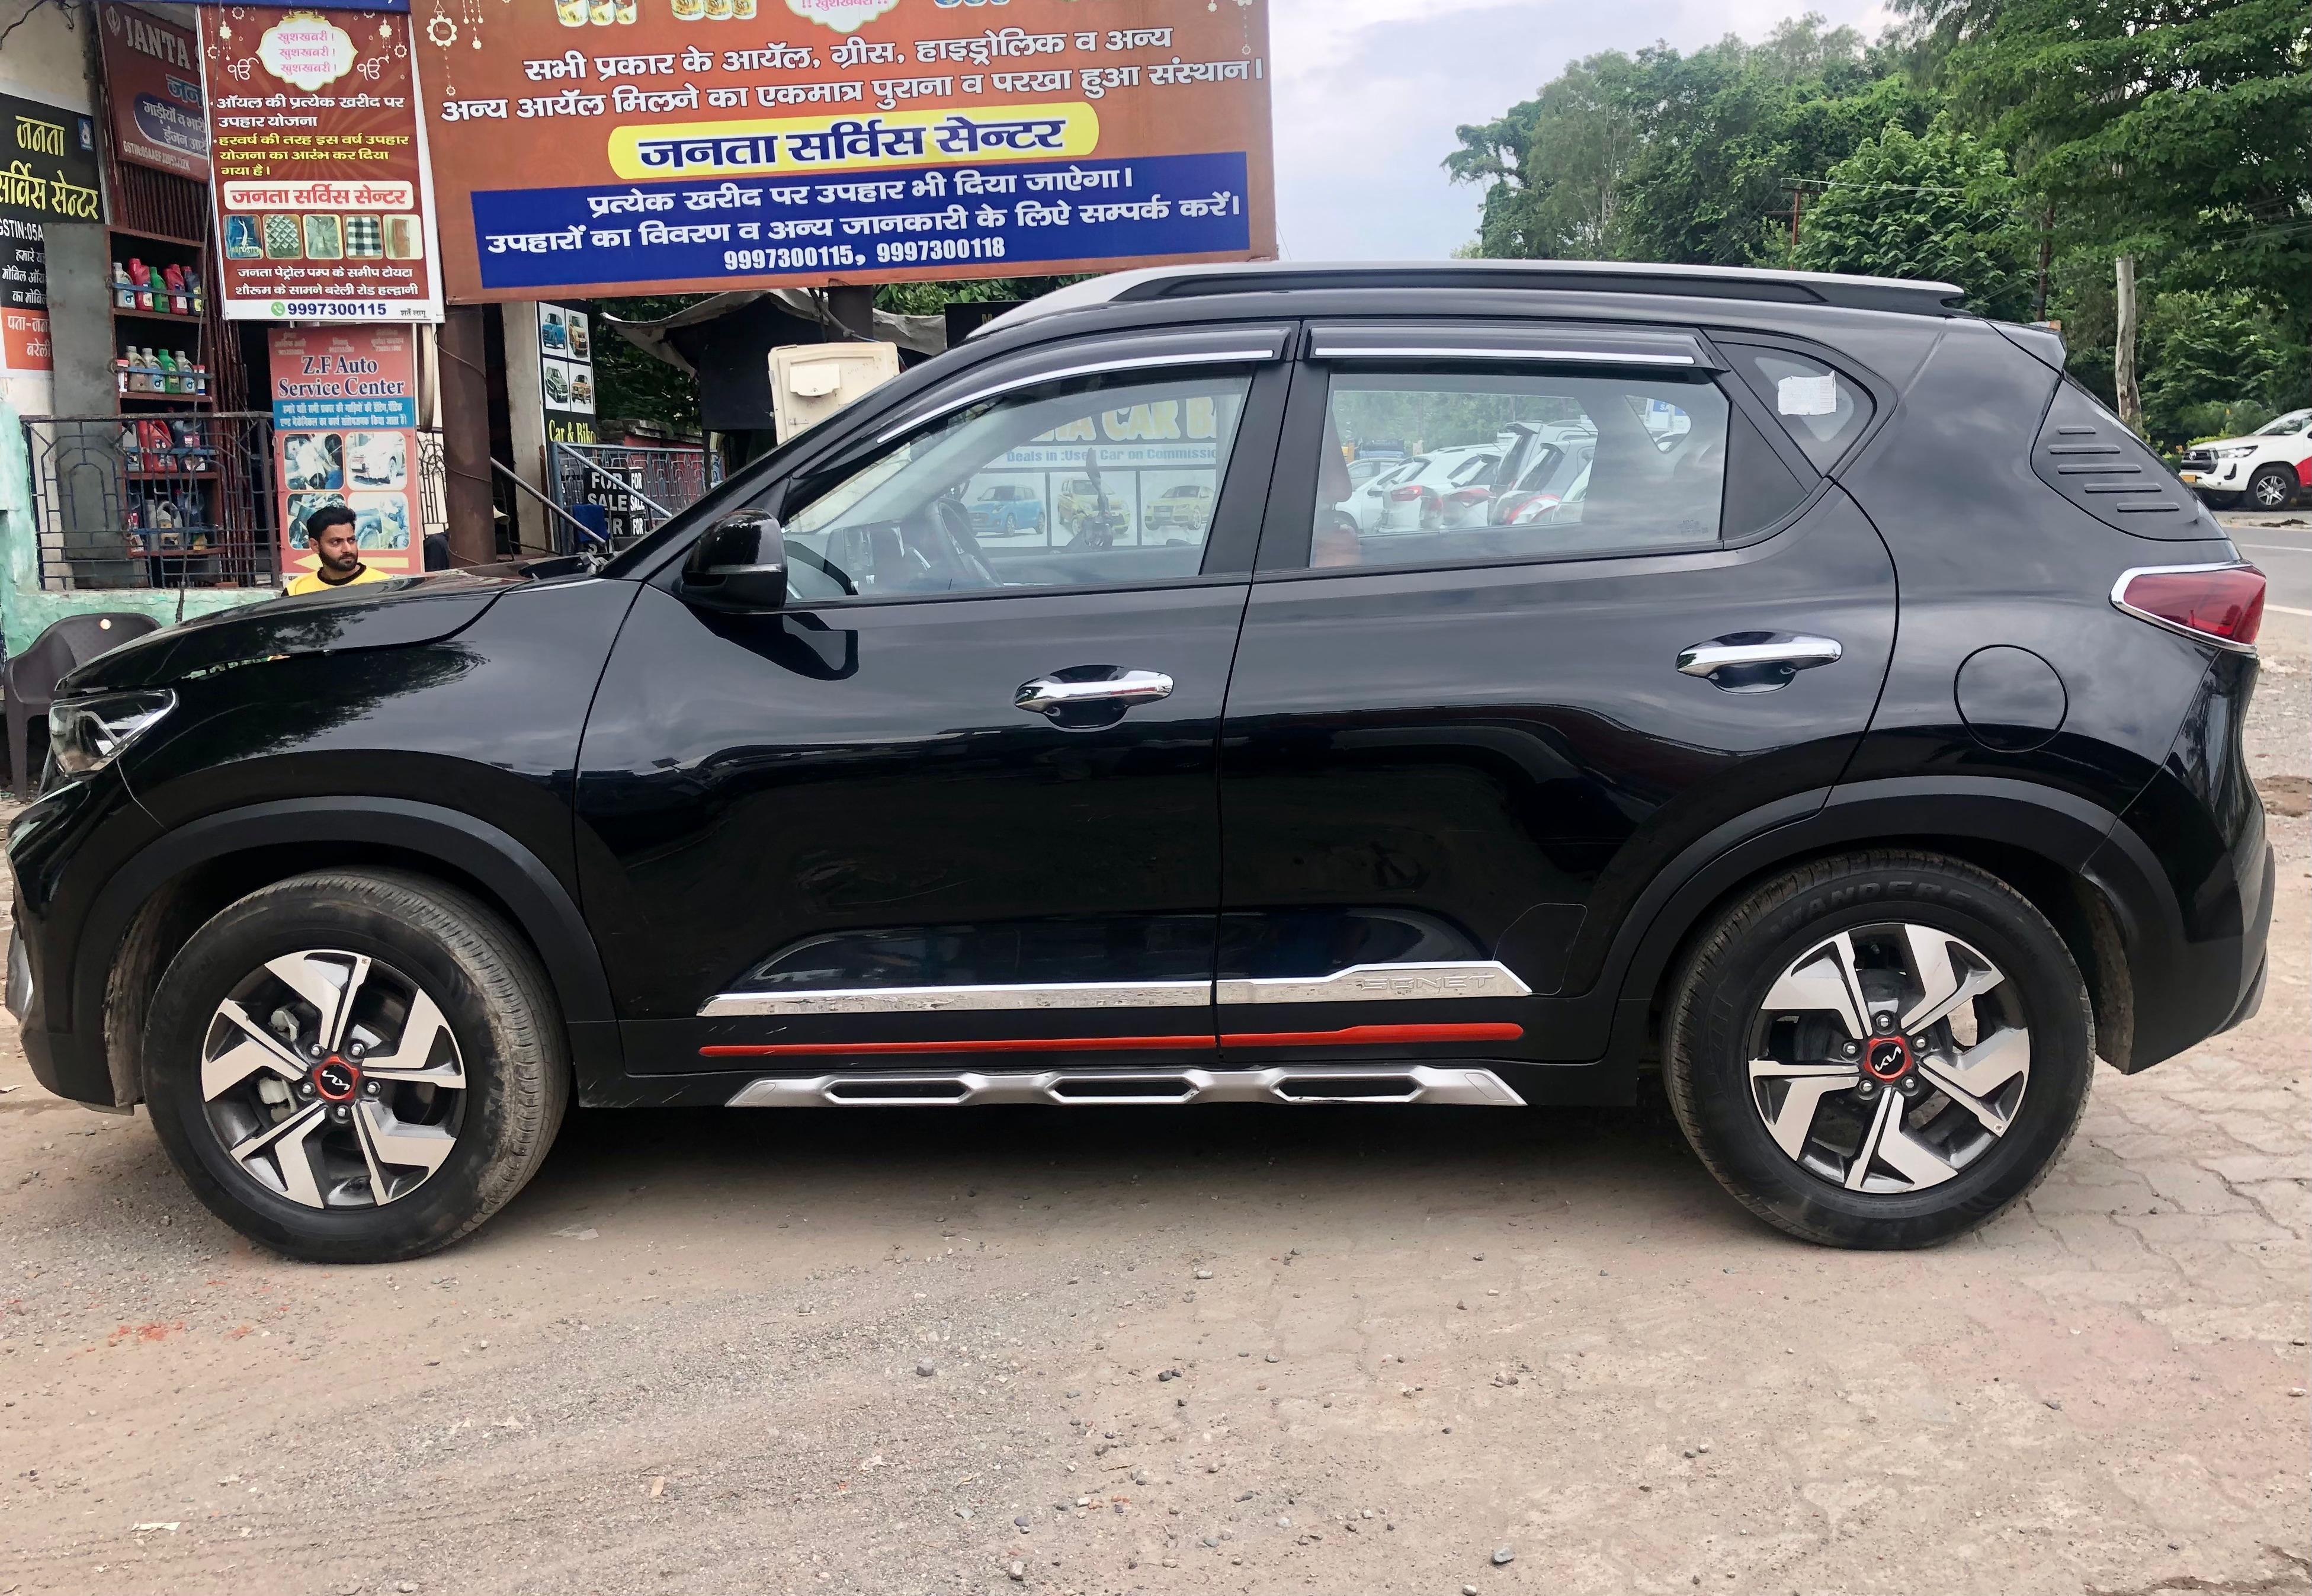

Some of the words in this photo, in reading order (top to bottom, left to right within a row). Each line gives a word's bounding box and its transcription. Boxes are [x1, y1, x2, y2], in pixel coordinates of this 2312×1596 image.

[124, 15, 191, 70] JANTA
[524, 50, 587, 82] सभी
[594, 54, 675, 82] प्रकार
[681, 45, 713, 72] के
[829, 36, 905, 69] ग्रीस,
[916, 28, 1067, 66] हाइड्रोलिक
[1075, 31, 1097, 52] व
[1105, 28, 1173, 50] अन्य
[441, 98, 509, 121] अन्य
[612, 83, 701, 114] मिलने
[707, 86, 749, 108] का
[755, 81, 864, 107] एकमात्र
[871, 75, 953, 110] पुराना
[961, 73, 984, 94] व
[991, 69, 1072, 91] परखा
[1079, 65, 1140, 98] हुआ
[1147, 57, 1262, 85] संस्थान।
[216, 94, 263, 110] ऑयल
[265, 94, 287, 108] की
[289, 94, 336, 110] प्रत्येक
[338, 93, 381, 108] खरीद
[383, 97, 406, 108] पर
[218, 116, 265, 129] उपहार
[267, 113, 318, 128] योजना
[15, 116, 65, 156] जनता
[218, 133, 258, 147] हरवर्ष
[260, 133, 281, 146] की
[283, 136, 312, 146] तरह
[316, 135, 338, 146] इस
[341, 133, 363, 145] वर्ष
[365, 135, 411, 146] उपहार
[638, 135, 778, 169] जनता
[787, 118, 926, 161] सर्विस
[935, 116, 1067, 152] सेन्टर
[220, 149, 267, 161] योजना
[268, 150, 288, 160] का
[291, 149, 329, 161] आरंभ
[332, 151, 357, 161] कर
[358, 148, 389, 161] दिया
[220, 166, 249, 176] गया
[50, 169, 99, 220] सेन्टर
[230, 190, 290, 204] जनता
[293, 184, 350, 204] सर्विस
[354, 184, 407, 204] सेन्टर
[587, 187, 676, 218] प्रत्येक
[683, 182, 763, 211] खरीद
[769, 186, 810, 205] पर
[816, 180, 906, 204] उपहार
[912, 172, 947, 198] भी
[953, 169, 1018, 196] दिया
[486, 225, 587, 254] उपहारों
[589, 228, 632, 248] का
[639, 220, 730, 245] विवरण
[738, 222, 761, 240] व
[768, 218, 834, 238] अन्य
[839, 205, 969, 235] जानकारी
[976, 203, 1007, 228] के
[1078, 194, 1172, 223] सम्पर्क
[15, 247, 34, 262] हमारे
[724, 244, 867, 271] 9997300115,
[876, 236, 1006, 262] 9997300118
[2, 264, 26, 282] मोबिल
[28, 268, 46, 283] ऑय
[237, 268, 272, 277] जनता
[274, 265, 306, 280] पेट्रोल
[307, 268, 330, 277] पम्प
[332, 266, 345, 277] के
[347, 265, 380, 278] समीप
[381, 265, 413, 277] टोयटा
[12, 290, 24, 303] का
[273, 283, 286, 294] के
[288, 283, 323, 295] सामने
[357, 283, 376, 295] रोड
[288, 303, 387, 315] 9997300115
[302, 355, 332, 375] Z.F
[335, 355, 377, 374] Auto
[278, 377, 340, 398] Service
[344, 377, 405, 396] Center
[549, 419, 565, 443] Car
[1007, 450, 1042, 463] Deals
[1046, 450, 1057, 462] in
[1100, 448, 1125, 461] Car
[1128, 450, 1143, 460] on
[592, 472, 623, 490] FOR
[631, 472, 643, 489] FOR
[588, 493, 627, 511] SALE
[632, 517, 643, 536] FOR
[1361, 974, 1495, 992] SONET
